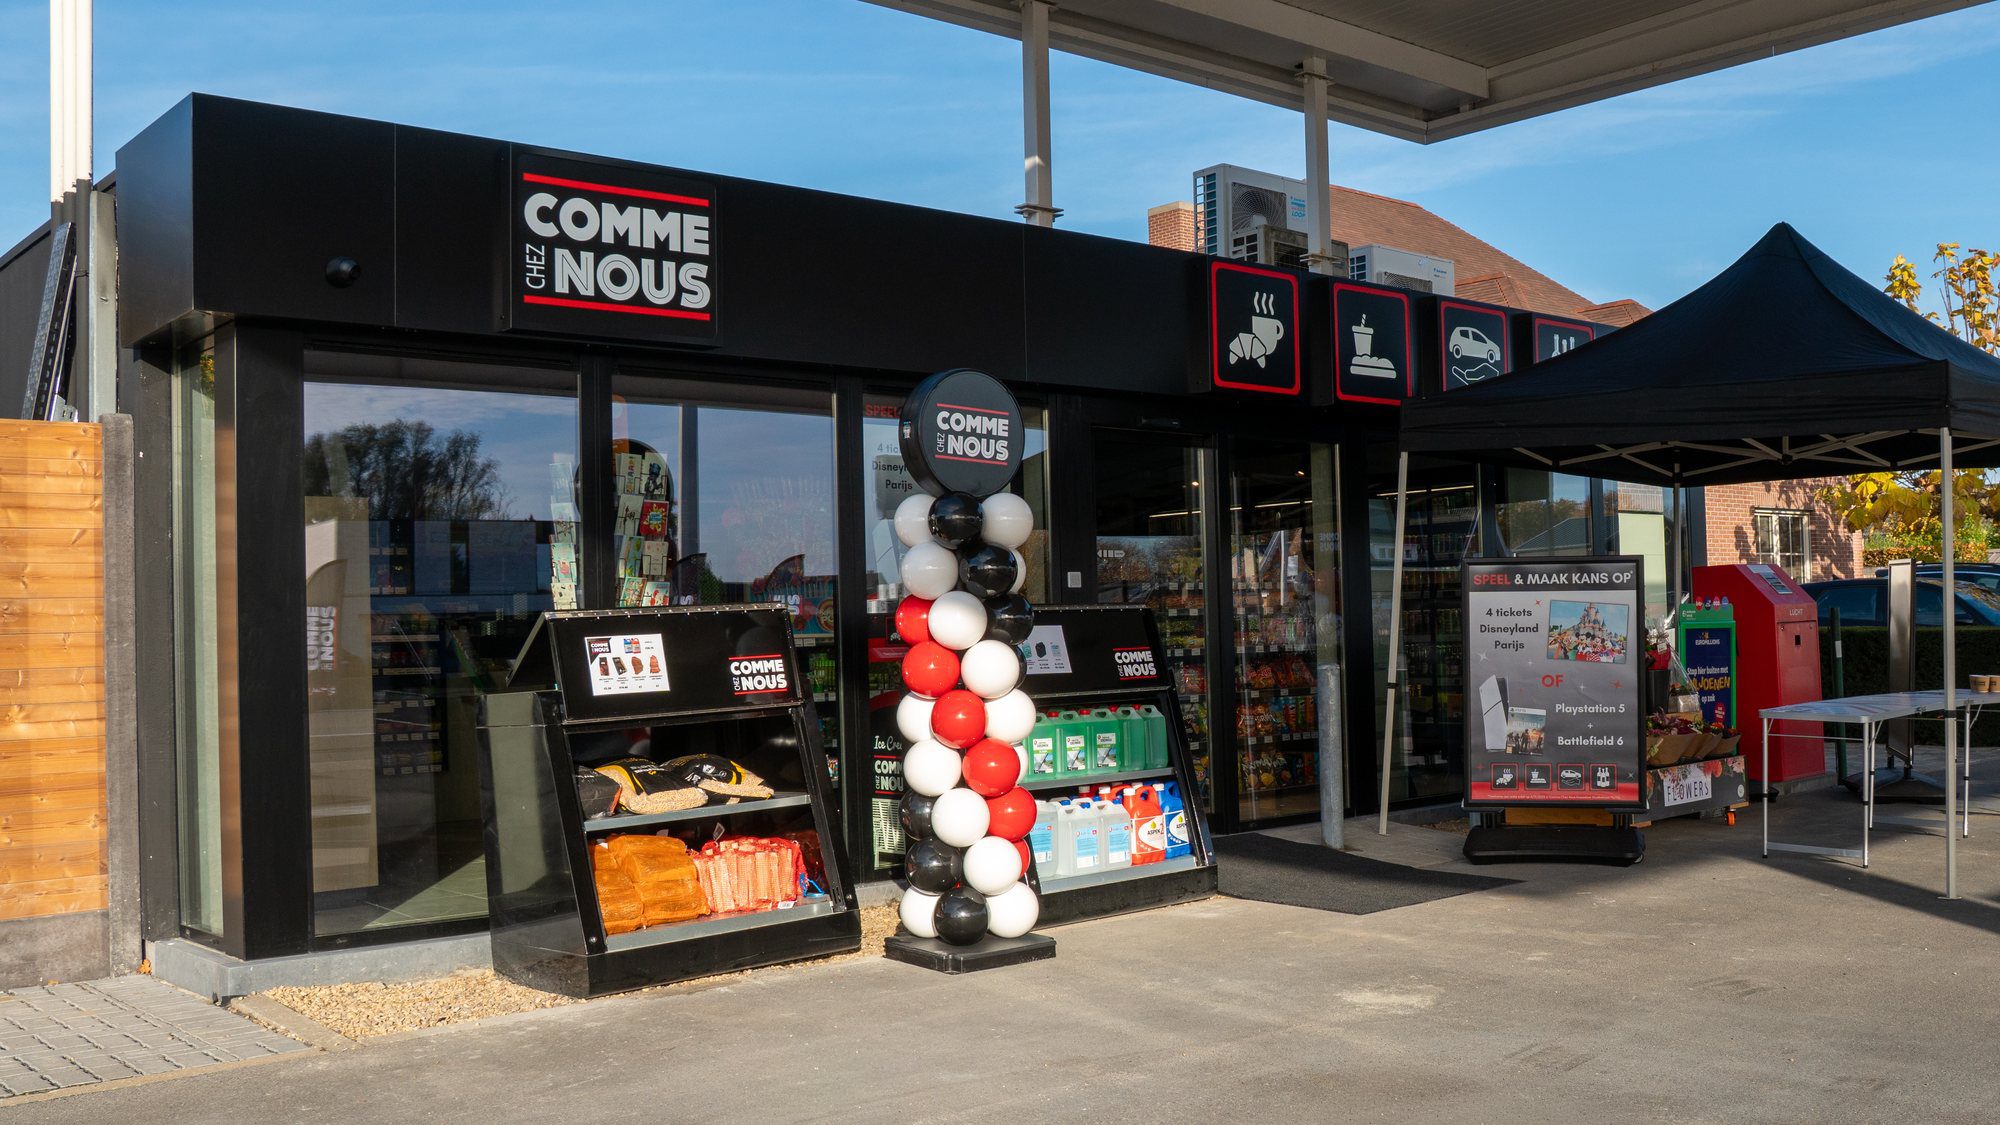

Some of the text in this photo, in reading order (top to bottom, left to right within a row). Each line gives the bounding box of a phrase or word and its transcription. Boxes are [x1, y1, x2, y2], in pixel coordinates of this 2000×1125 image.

[524, 192, 710, 256] COMME
[525, 243, 545, 289] CHEZ
[554, 247, 711, 309] NOUS
[936, 410, 1009, 437] COMME
[936, 432, 945, 453] CHEZ
[947, 435, 1009, 461] NOUS
[872, 460, 908, 474] Disney
[885, 479, 913, 493] Parijs
[1473, 574, 1511, 586] SPEEL
[1514, 574, 1524, 585] &
[1527, 573, 1569, 586] MAAK
[1572, 572, 1609, 584] KANS
[1485, 607, 1532, 618] 4 tickets
[1479, 623, 1539, 637] Disneyland
[1494, 640, 1525, 653] Parijs
[1114, 650, 1153, 664] COMME
[730, 659, 784, 675] COMME
[1123, 662, 1157, 676] NOUS
[741, 674, 787, 691] NOUS
[1541, 674, 1564, 688] OF
[1555, 703, 1625, 716] Playstation 5
[873, 735, 902, 751] Ice Cre
[1557, 735, 1624, 746] Battlefield 6
[874, 759, 903, 774] COMM
[880, 775, 904, 791] NOU
[1667, 780, 1709, 802] FLOWERS
